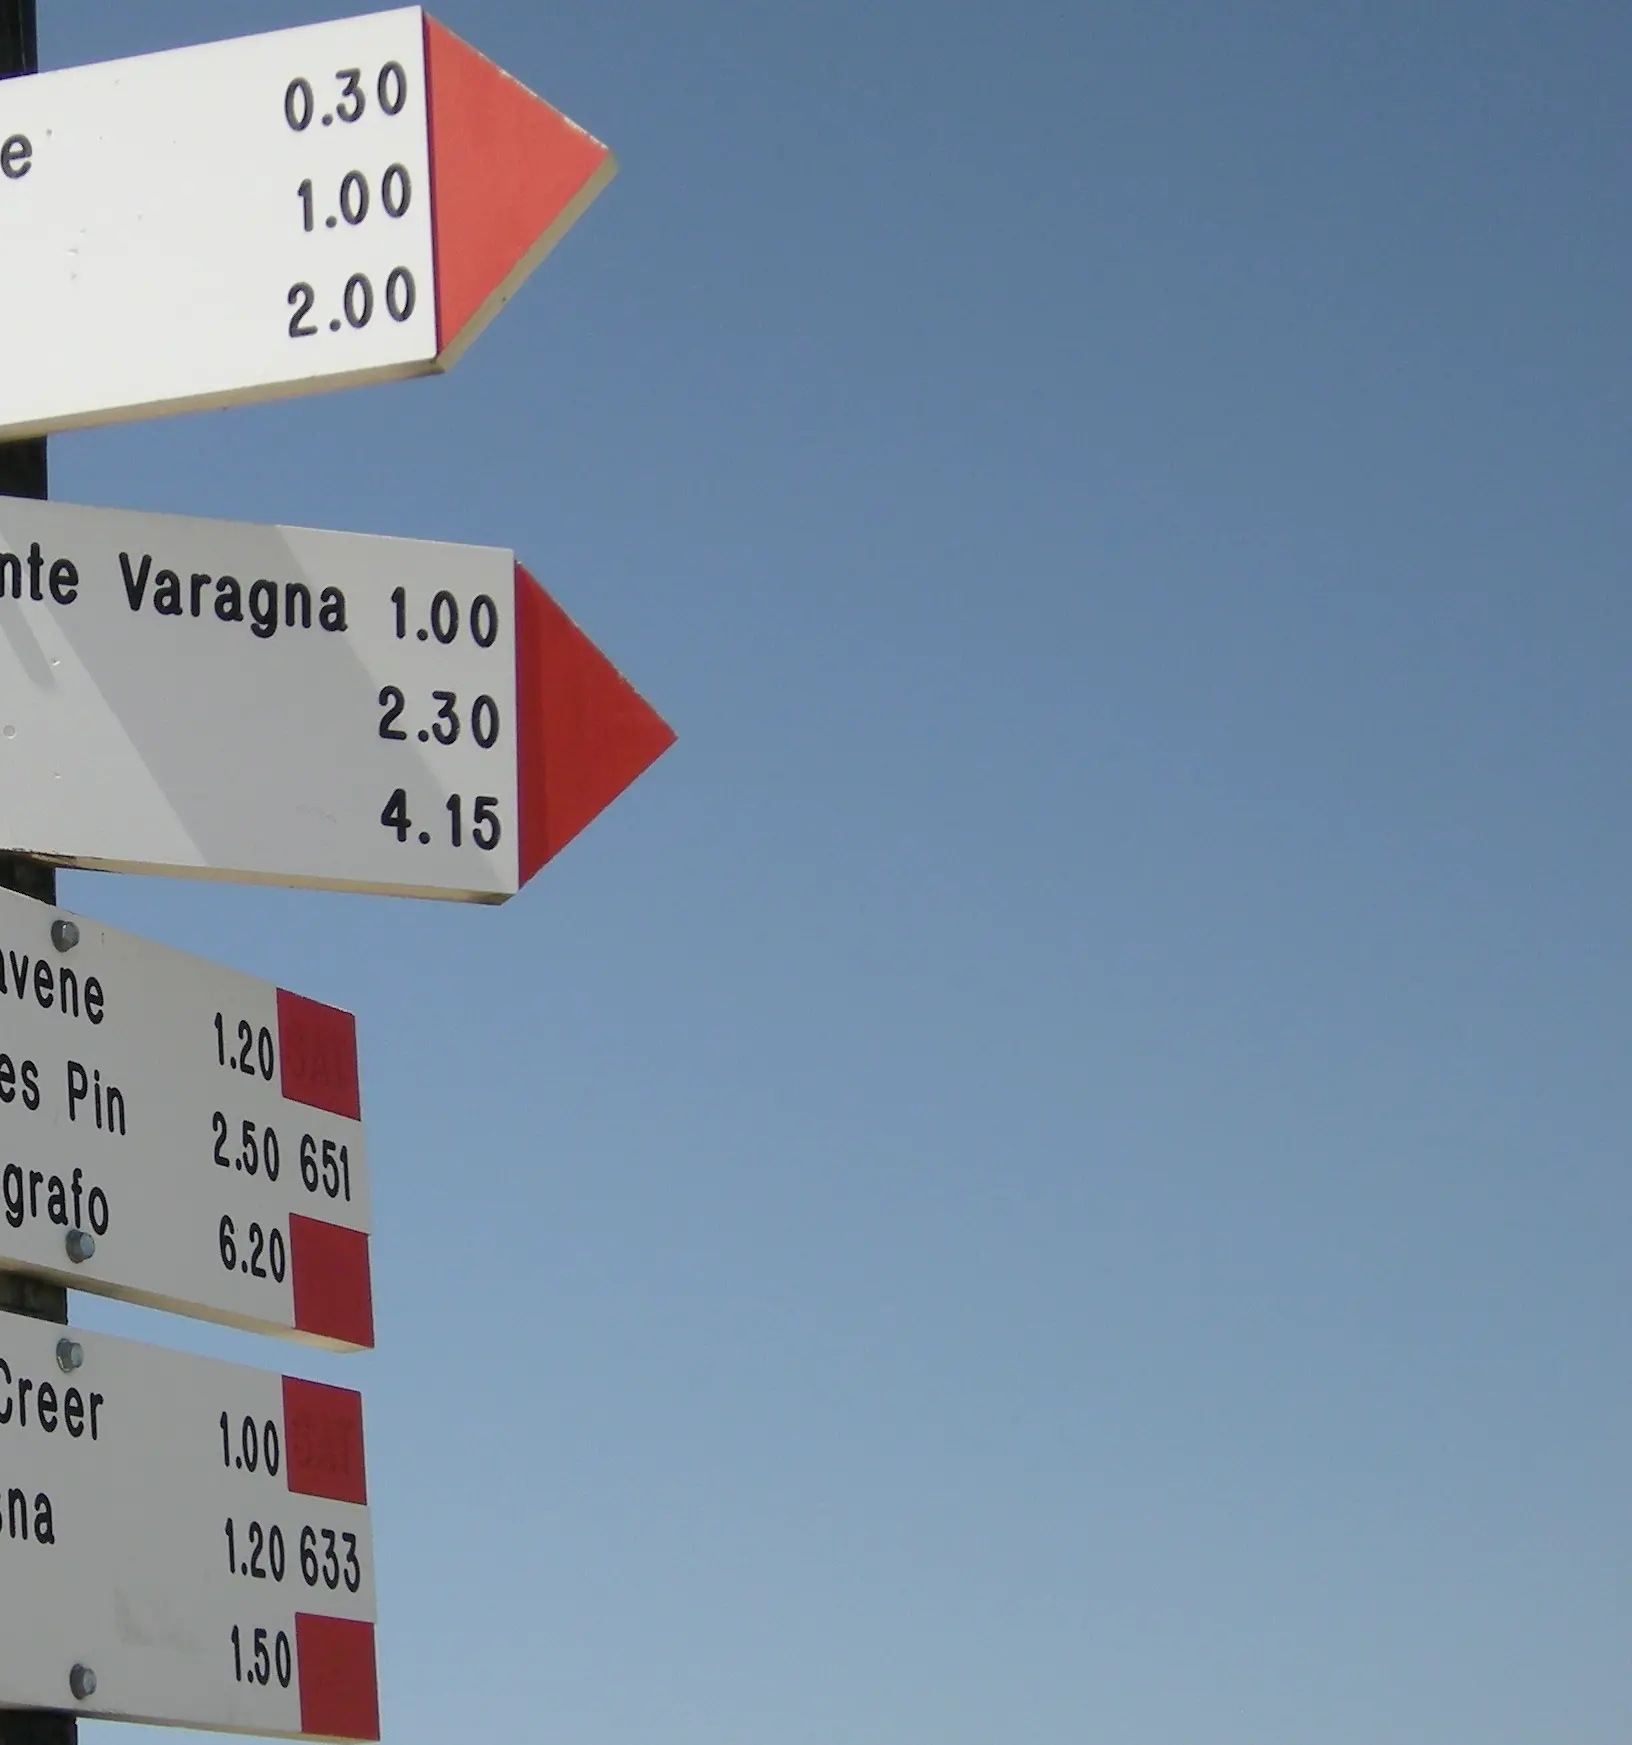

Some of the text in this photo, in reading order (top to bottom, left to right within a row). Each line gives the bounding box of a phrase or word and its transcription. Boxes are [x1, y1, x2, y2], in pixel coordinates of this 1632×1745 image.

[284, 62, 406, 131] 0.30
[297, 164, 410, 231] 1.00
[287, 267, 414, 338] 2.00
[118, 551, 349, 640] Varagna
[390, 586, 499, 649] 1.00
[378, 685, 500, 750] 2.30
[380, 787, 501, 851] 4.15
[213, 1011, 275, 1082] 1.20
[66, 1059, 127, 1137] Pin
[211, 1110, 281, 1183] 2.50
[299, 1133, 352, 1203] 651
[218, 1214, 287, 1284] 6.20
[219, 1410, 281, 1478] 1.00
[224, 1516, 286, 1583] 1.20
[299, 1524, 361, 1594] 633
[230, 1624, 292, 1689] 1.50
